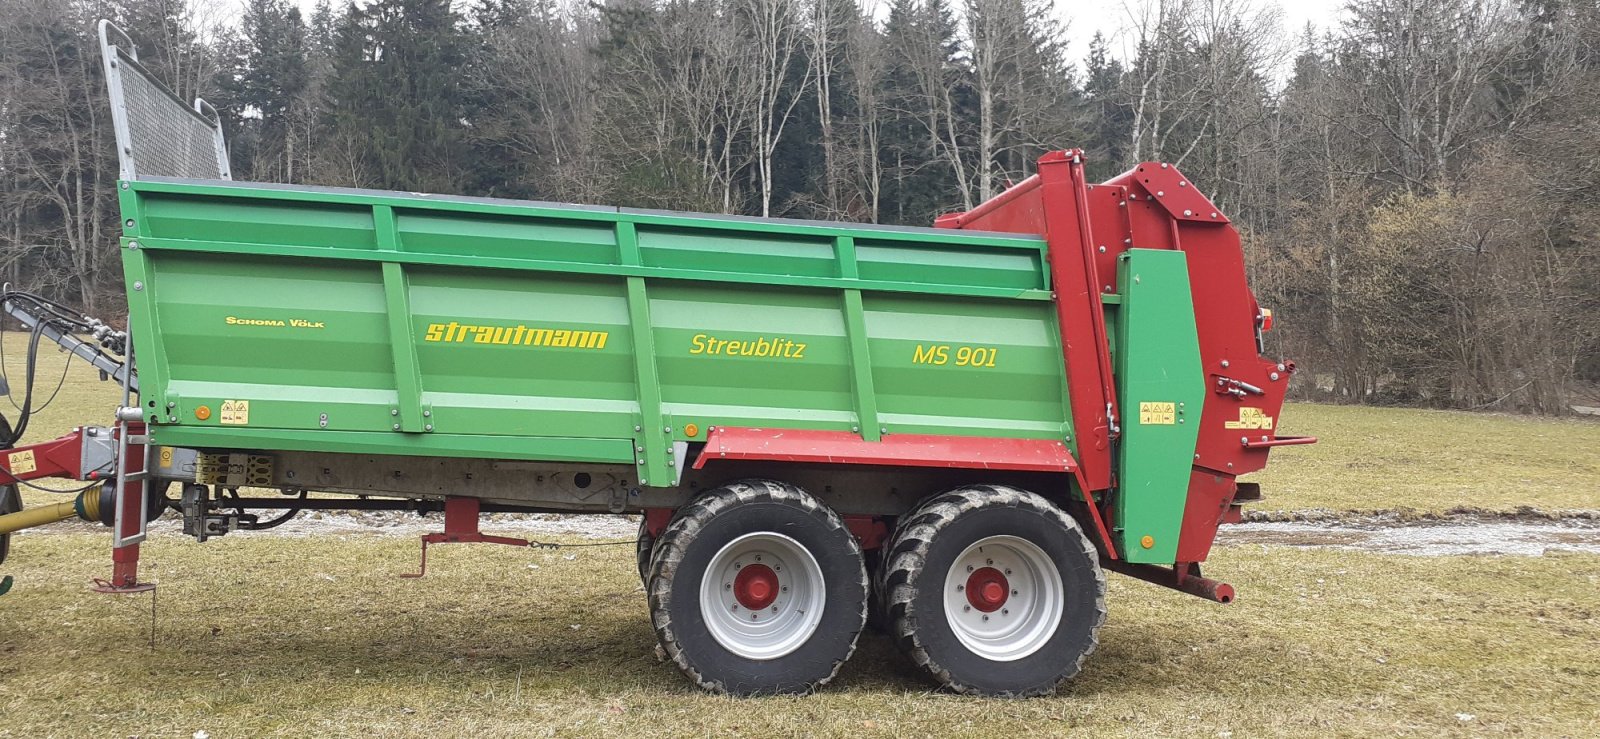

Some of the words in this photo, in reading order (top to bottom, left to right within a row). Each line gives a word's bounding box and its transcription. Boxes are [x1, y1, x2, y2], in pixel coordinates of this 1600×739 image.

[225, 316, 285, 327] SCHOMA
[425, 321, 608, 349] strautmann
[689, 333, 806, 358] Streublitz
[912, 344, 950, 365] MS
[956, 346, 997, 367] 901
